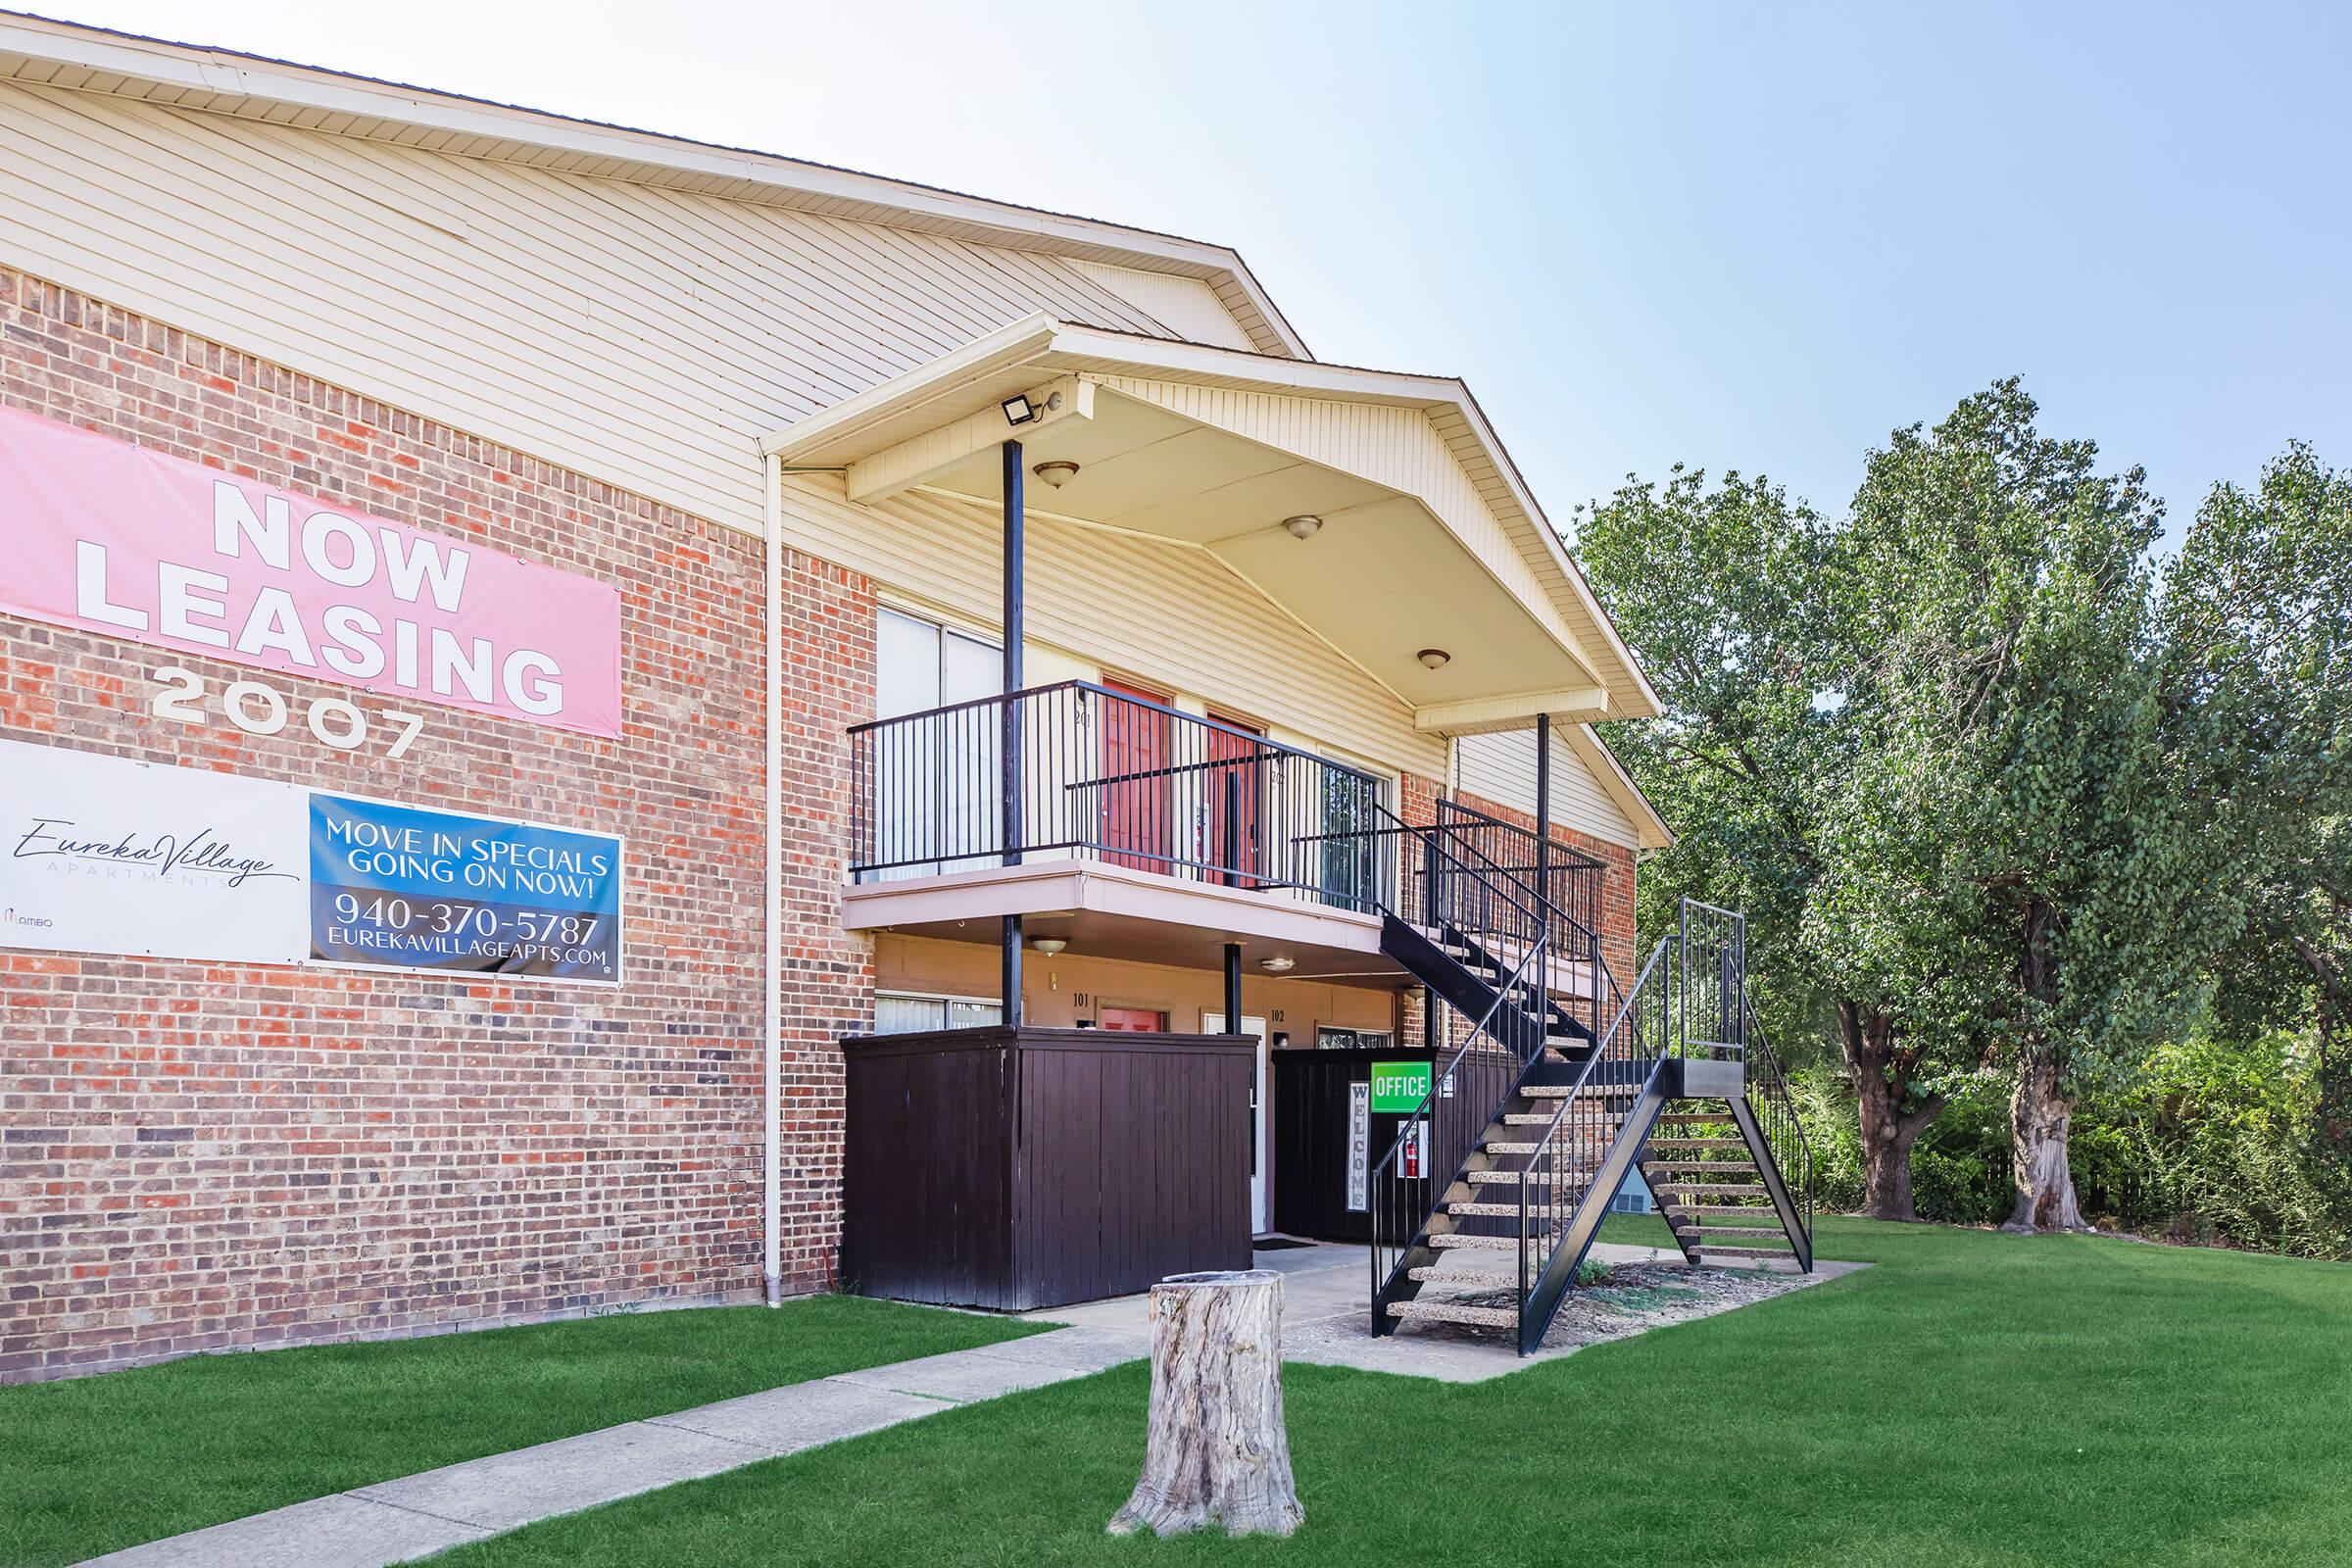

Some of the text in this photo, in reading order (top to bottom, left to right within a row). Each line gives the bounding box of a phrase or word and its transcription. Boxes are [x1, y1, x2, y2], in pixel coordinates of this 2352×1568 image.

[213, 479, 470, 613] NOW
[75, 539, 564, 716] LEASING
[152, 666, 424, 759] 2007
[13, 817, 300, 888] Eureka Village
[326, 817, 608, 876] MOVE IN SPECIALS
[47, 861, 229, 889] APARTMENTS
[348, 849, 594, 899] GOING ON NOW!
[328, 927, 606, 965] EUREKAVILLAGEAPTS.COM
[334, 893, 598, 946] 940-370-5787
[1073, 993, 1088, 1007] 101
[1271, 1009, 1285, 1022] 102
[1376, 1076, 1426, 1098] OFFICE
[1351, 1086, 1367, 1207] WELCOME
